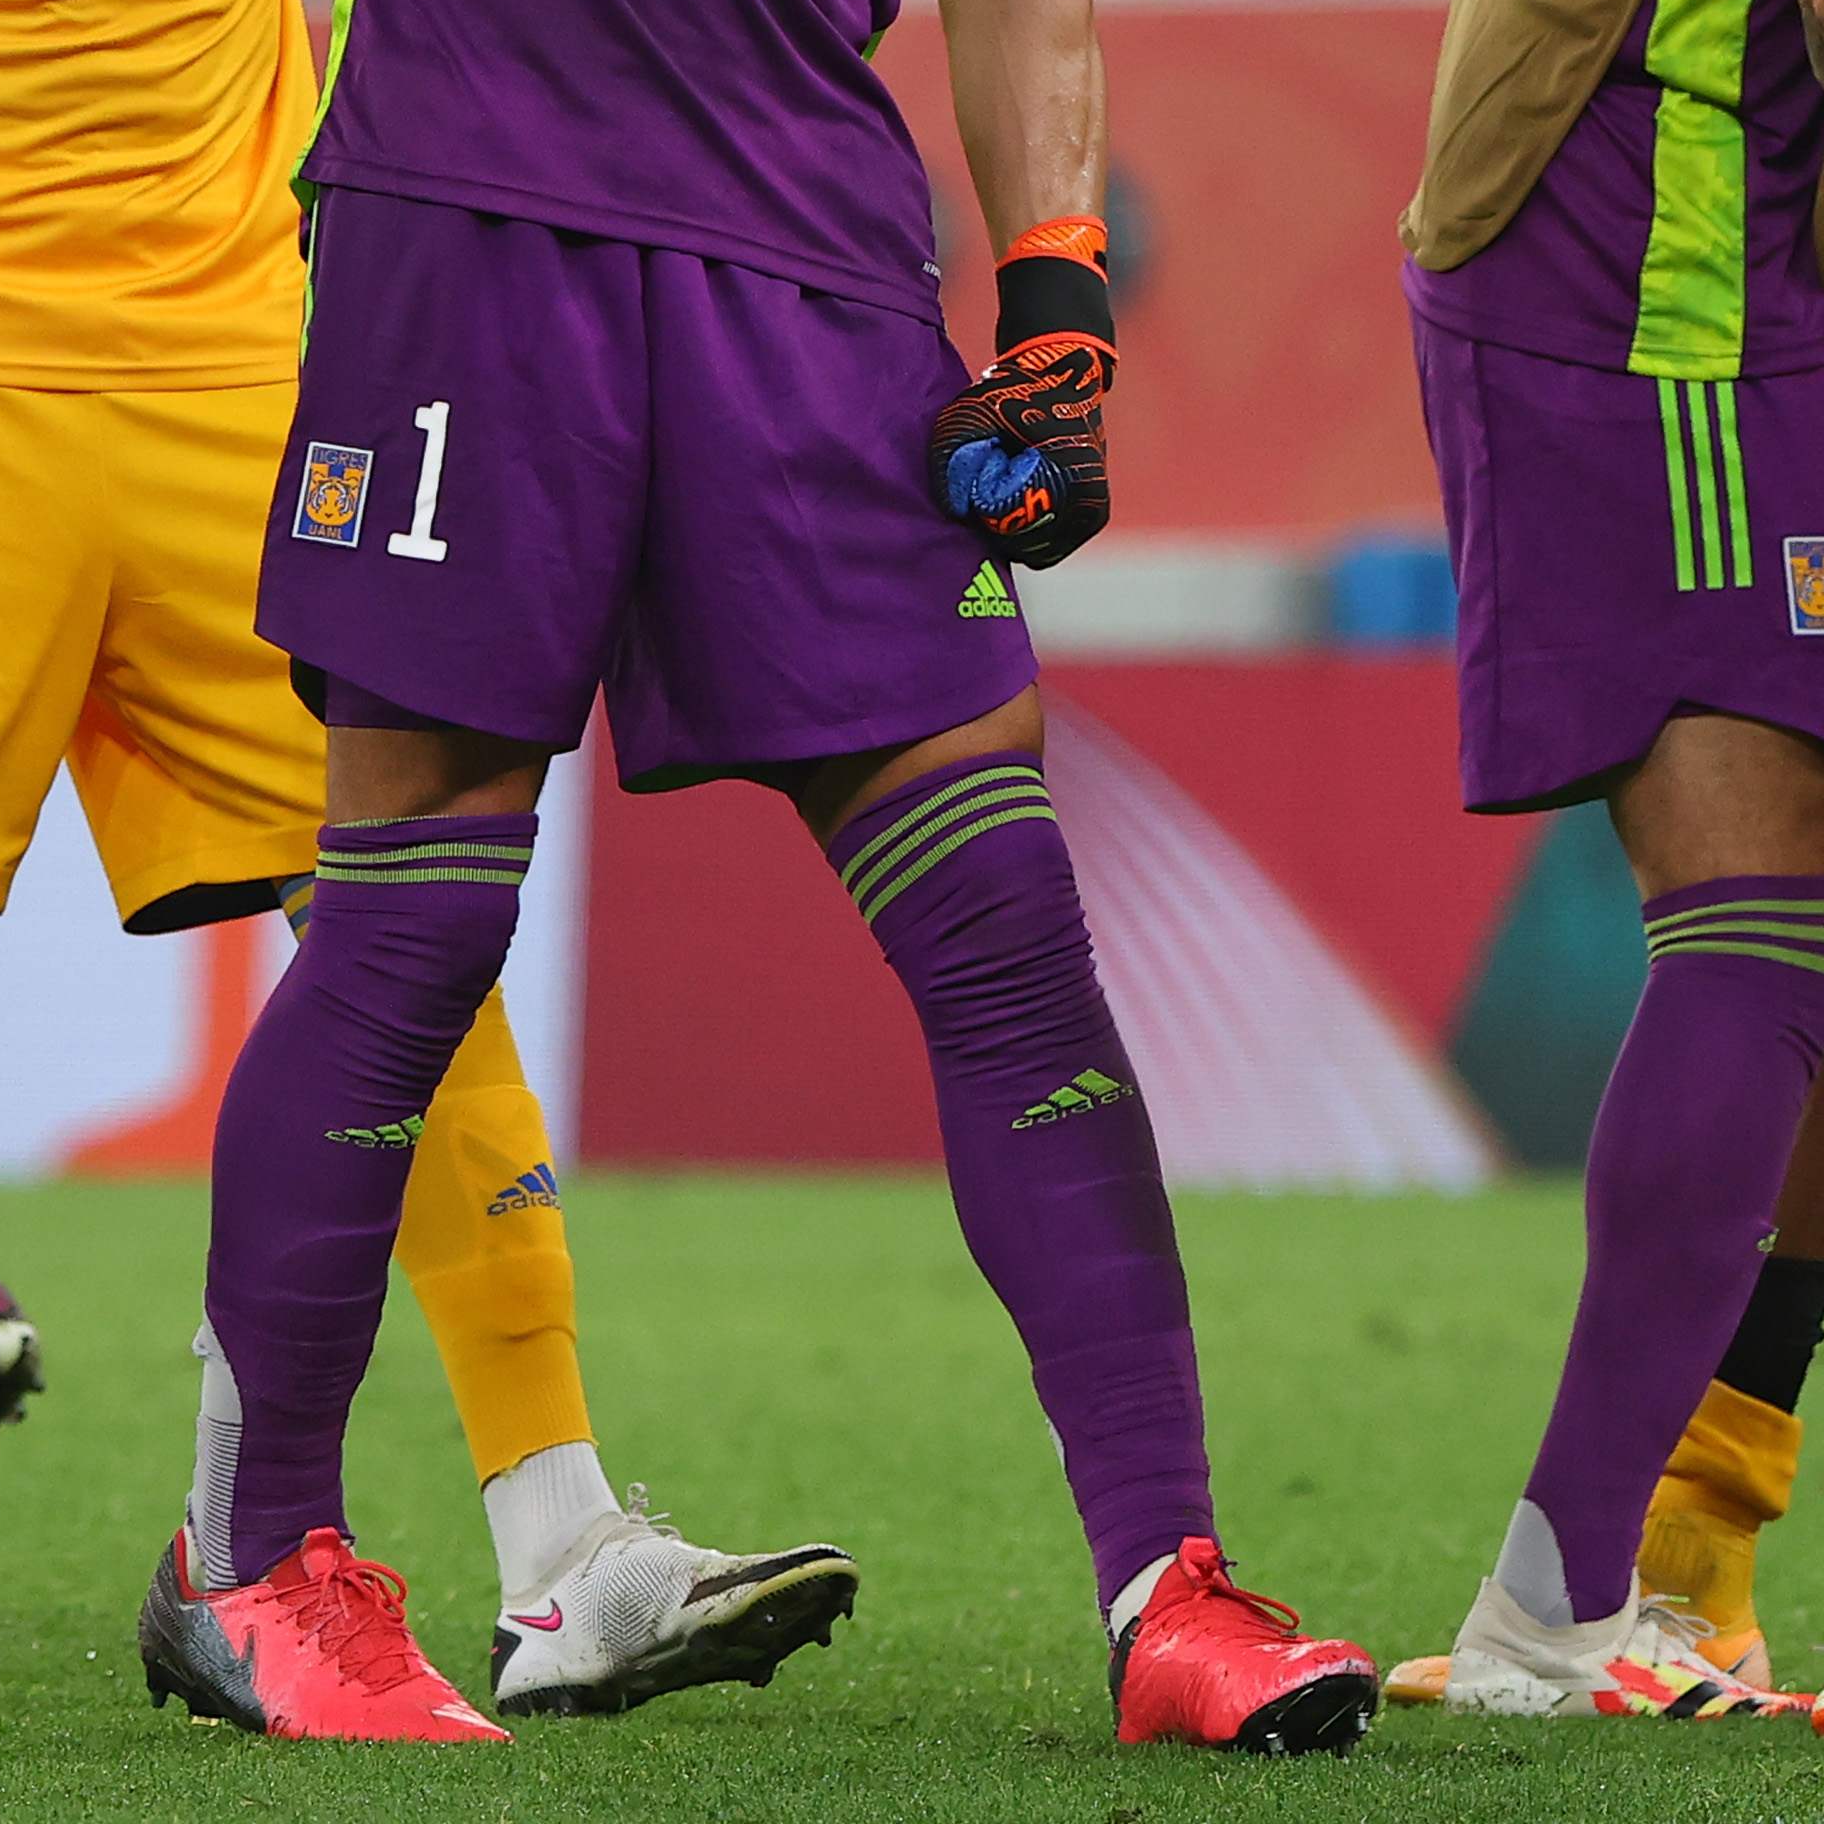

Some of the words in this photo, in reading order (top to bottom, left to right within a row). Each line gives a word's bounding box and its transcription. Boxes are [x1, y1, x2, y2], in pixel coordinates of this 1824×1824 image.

[313, 447, 369, 470] TIGRES
[387, 401, 450, 562] 1
[308, 524, 344, 540] UANL
[958, 596, 1017, 618] adidas
[1011, 1084, 1135, 1129] adidas
